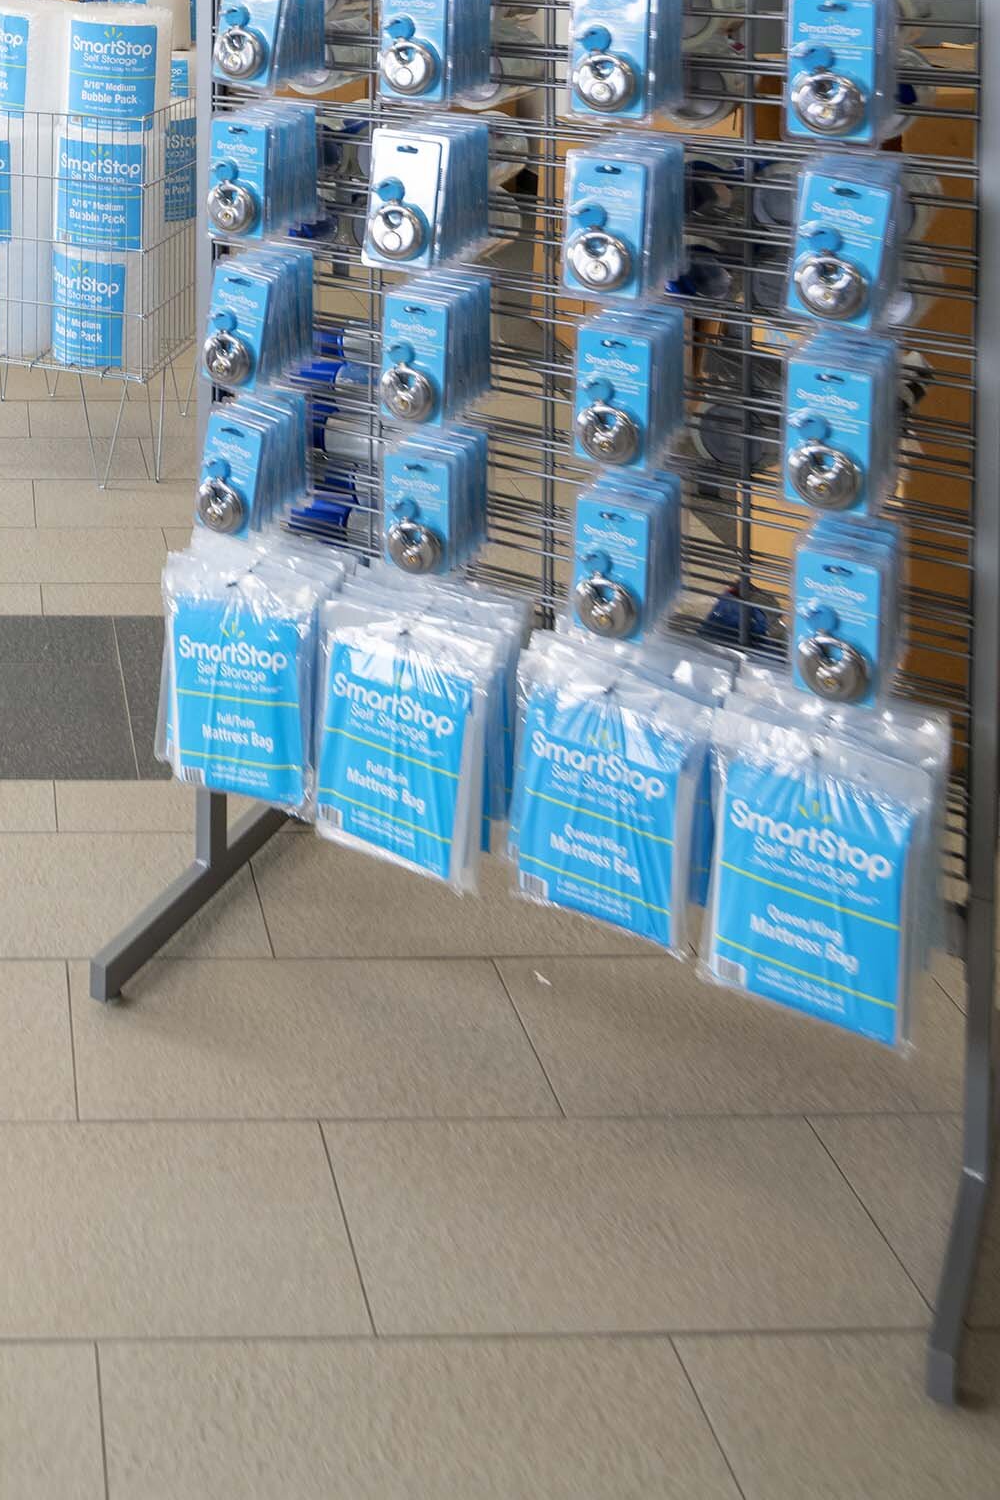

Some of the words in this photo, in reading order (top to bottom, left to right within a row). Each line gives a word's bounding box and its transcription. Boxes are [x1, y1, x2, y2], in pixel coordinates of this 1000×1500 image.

[72, 35, 153, 59] SmartStop
[83, 51, 100, 62] Self
[101, 54, 137, 66] Storage
[81, 89, 112, 104] Bubble
[114, 92, 138, 105] Pack
[105, 80, 137, 92] Medium
[60, 153, 142, 177] SmartStop
[93, 200, 124, 212] Medium
[102, 211, 127, 225] Pack
[54, 268, 119, 299] martStop
[67, 288, 104, 303] Storage
[179, 634, 288, 674] SmartStop
[197, 660, 217, 676] Self
[219, 662, 267, 683] Storage
[333, 671, 455, 739] SmartStop
[216, 711, 256, 729] Full/Twin
[350, 703, 375, 723] Self
[376, 712, 429, 744] Storage
[202, 723, 249, 746] Mattress
[251, 731, 274, 753] Bag
[365, 759, 409, 787] Full/Twin
[531, 729, 666, 801] SmartStop
[346, 766, 399, 802] Mattress
[402, 788, 427, 816] Bag
[730, 798, 893, 883] SmartStop
[550, 831, 611, 870] Mattress
[613, 855, 642, 886] Bag
[753, 835, 786, 860] Self
[789, 847, 860, 888] Storage
[750, 912, 825, 959] Mattress
[824, 942, 861, 977] Bag
